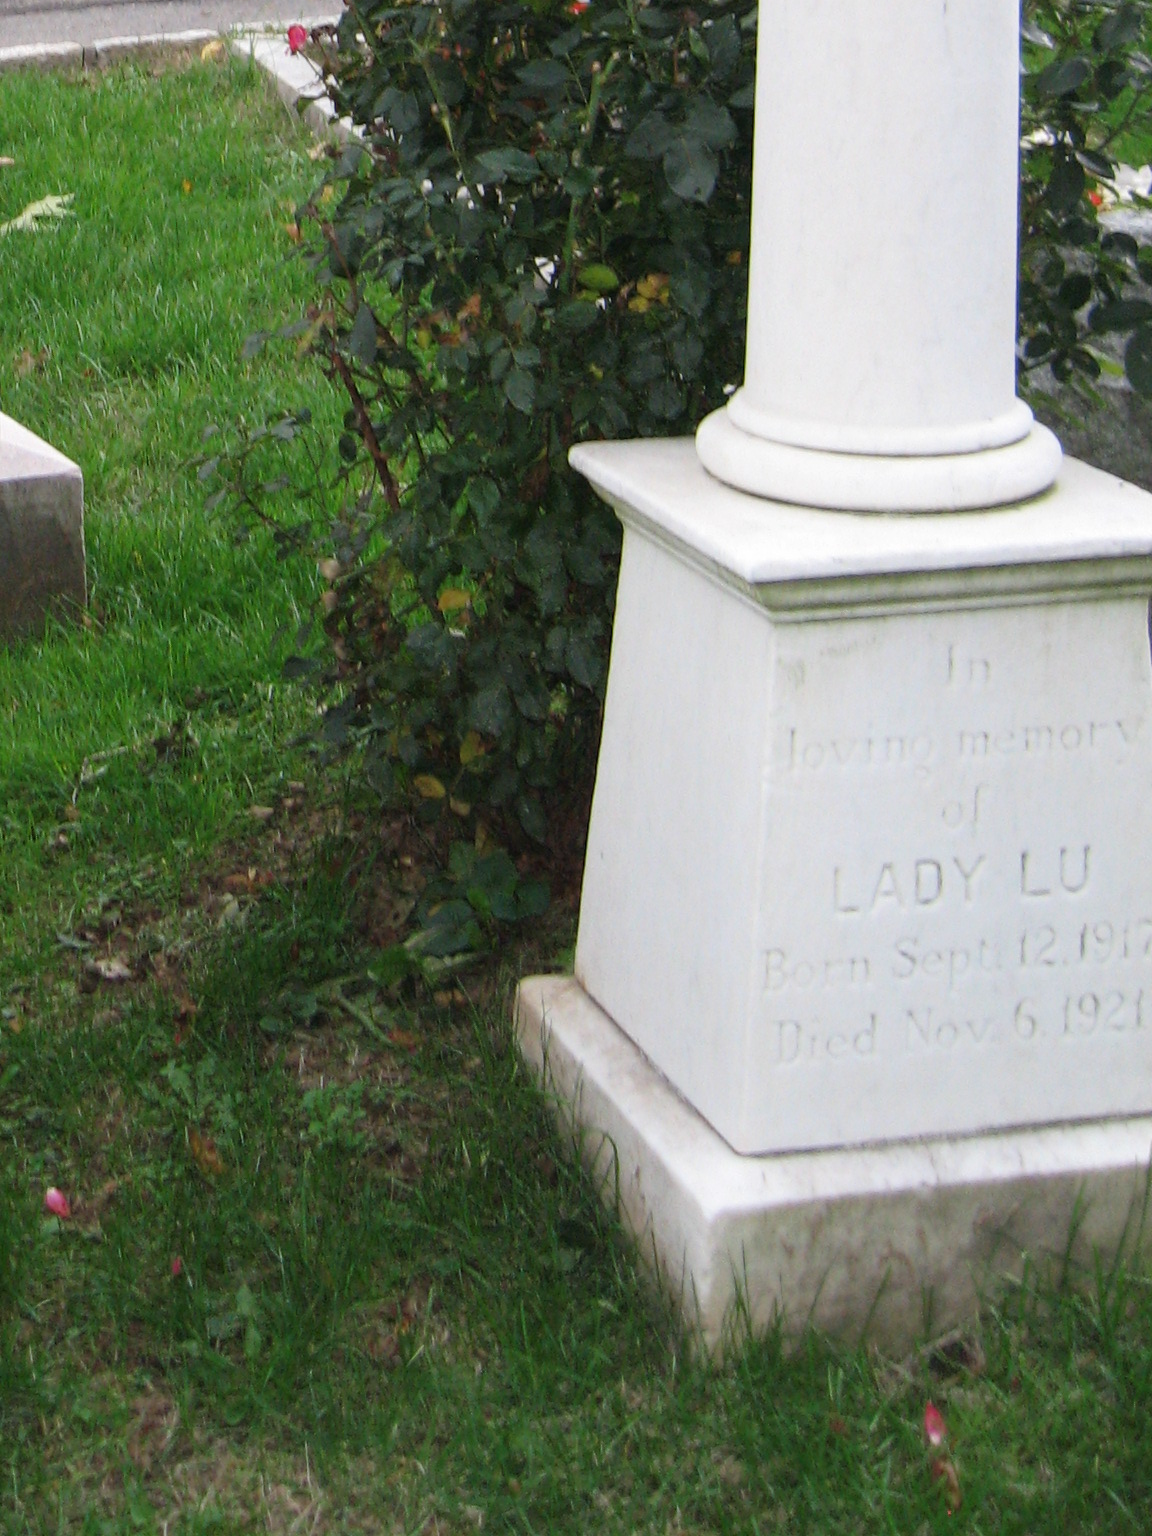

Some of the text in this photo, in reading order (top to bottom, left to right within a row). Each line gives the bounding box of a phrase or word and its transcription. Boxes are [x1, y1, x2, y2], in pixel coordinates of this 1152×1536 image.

[946, 644, 991, 685] In
[789, 716, 1143, 781] loving memory
[941, 783, 990, 834] of
[833, 843, 1091, 914] LADY LU
[762, 946, 871, 991] Born
[771, 1010, 877, 1064] Died
